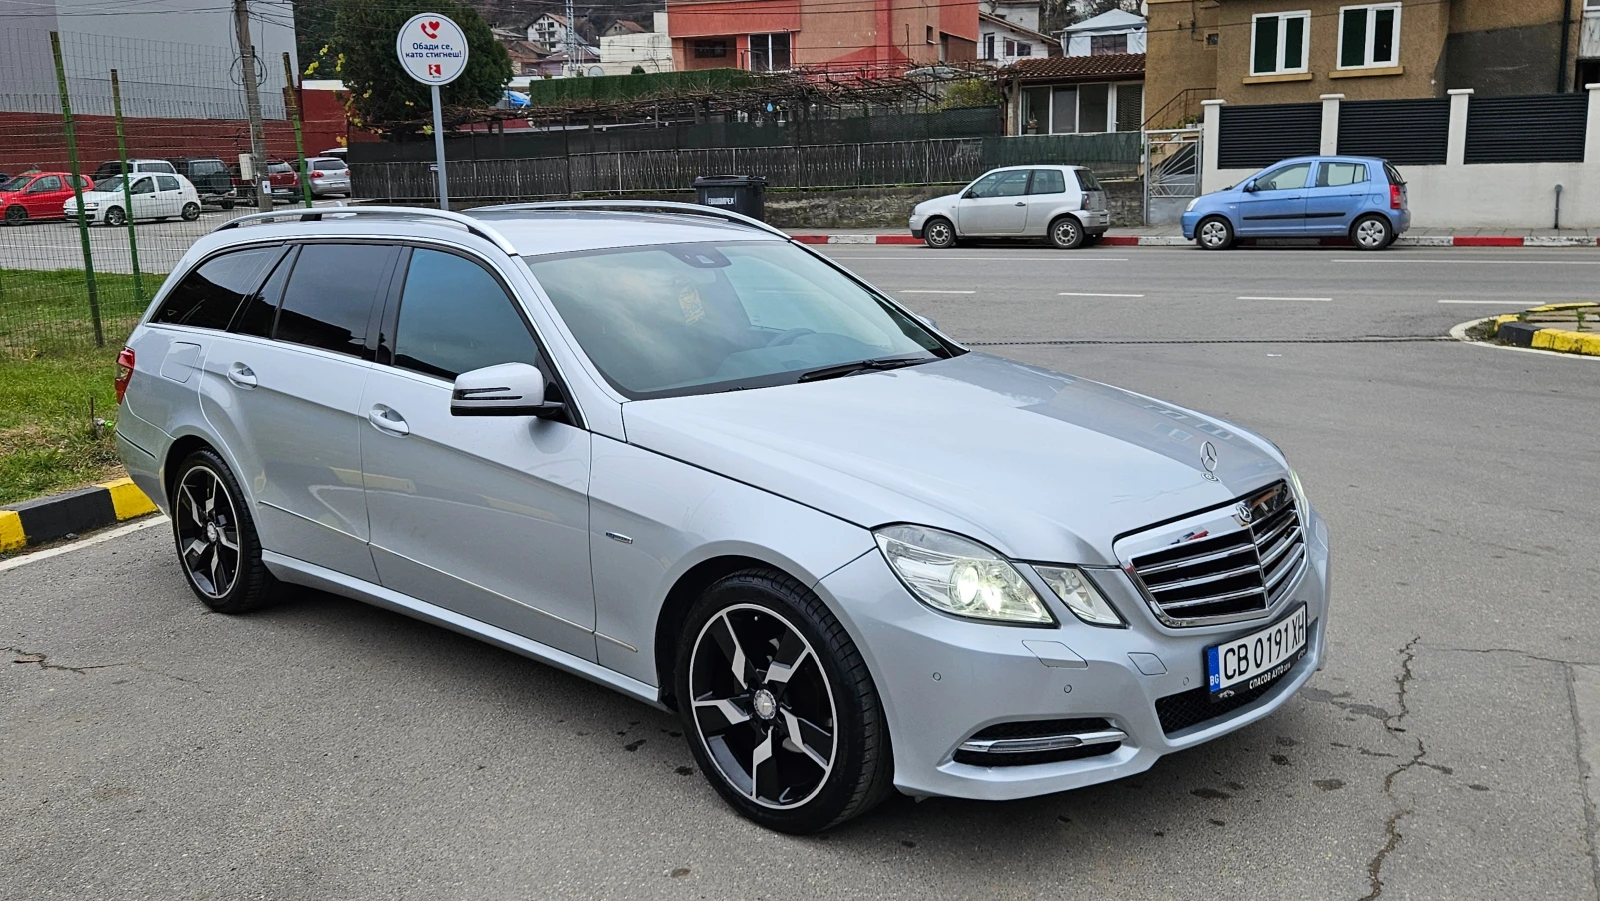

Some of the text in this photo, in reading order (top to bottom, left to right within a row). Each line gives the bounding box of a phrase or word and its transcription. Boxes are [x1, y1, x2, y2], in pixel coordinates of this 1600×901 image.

[412, 42, 438, 50] Обади
[1224, 610, 1305, 681] CB 0191 XH
[1209, 673, 1220, 687] BG
[1249, 672, 1271, 690] СПАСОВ
